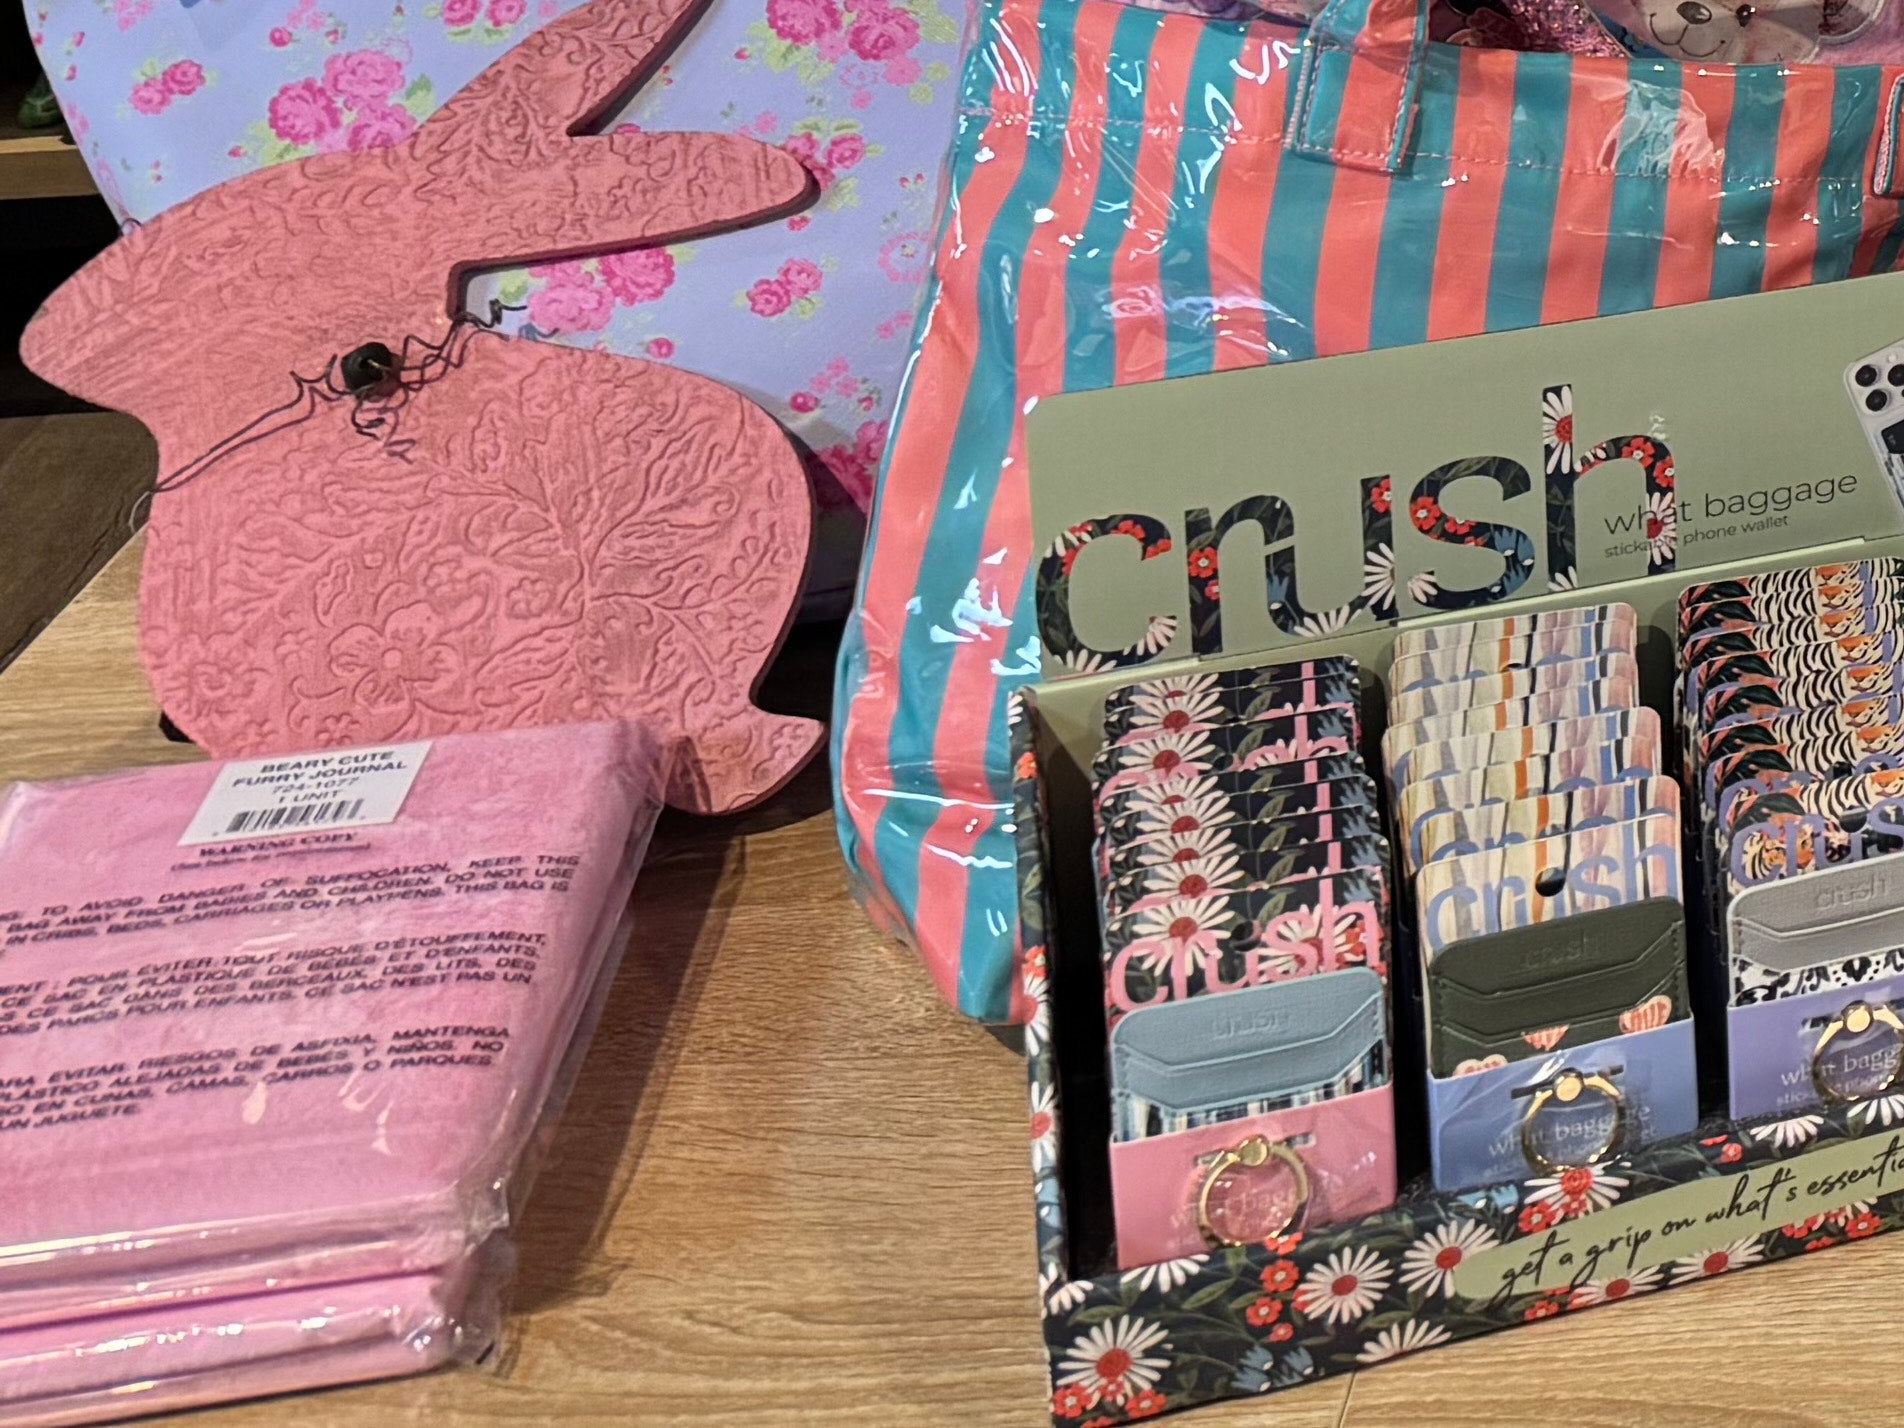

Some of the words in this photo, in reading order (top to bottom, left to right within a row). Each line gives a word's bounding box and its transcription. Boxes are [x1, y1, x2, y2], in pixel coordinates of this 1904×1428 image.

[1604, 499, 1692, 535] what
[1705, 474, 1858, 517] baggage
[1036, 383, 1675, 665] crush
[1683, 525, 1737, 545] phone
[1741, 515, 1790, 535] wallet
[233, 772, 305, 787] FURRY
[309, 761, 407, 778] JOURNAL
[261, 757, 335, 773] BEARY
[338, 751, 394, 764] CUTE
[272, 777, 360, 794] 724-1077
[292, 790, 341, 802] UNIT
[42, 905, 68, 916] TO
[79, 897, 144, 912] AVOID
[158, 883, 245, 904] DANGER
[260, 877, 290, 888] OF
[470, 856, 521, 868] KEEP
[537, 855, 580, 866] THIS
[1427, 834, 1680, 950] crush
[7, 919, 50, 933] BAG
[56, 912, 118, 926] AWAY
[124, 904, 185, 919] FROM
[194, 892, 267, 910] BABIES
[274, 888, 318, 899] AND
[445, 871, 476, 884] DO
[483, 868, 525, 879] NOT
[534, 868, 575, 879] USE
[174, 901, 294, 924] CARRIAGES
[299, 898, 330, 910] OR
[454, 881, 499, 894] THIS
[503, 880, 545, 891] BAG
[551, 880, 570, 892] IS
[286, 944, 364, 961] RISQUE
[388, 950, 415, 962] ET
[1110, 876, 1381, 1012] crush
[382, 962, 424, 976] DES
[495, 958, 536, 971] DES
[456, 971, 496, 982] PAS
[502, 973, 532, 984] UN
[392, 1025, 510, 1041] MANTENGA
[472, 1041, 504, 1052] NO
[390, 1055, 492, 1070] PARQUES
[1489, 1229, 1555, 1307] get
[1559, 1250, 1575, 1267] a
[1576, 1227, 1653, 1288] grip
[1660, 1217, 1696, 1238] on
[1705, 1168, 1799, 1225] what's
